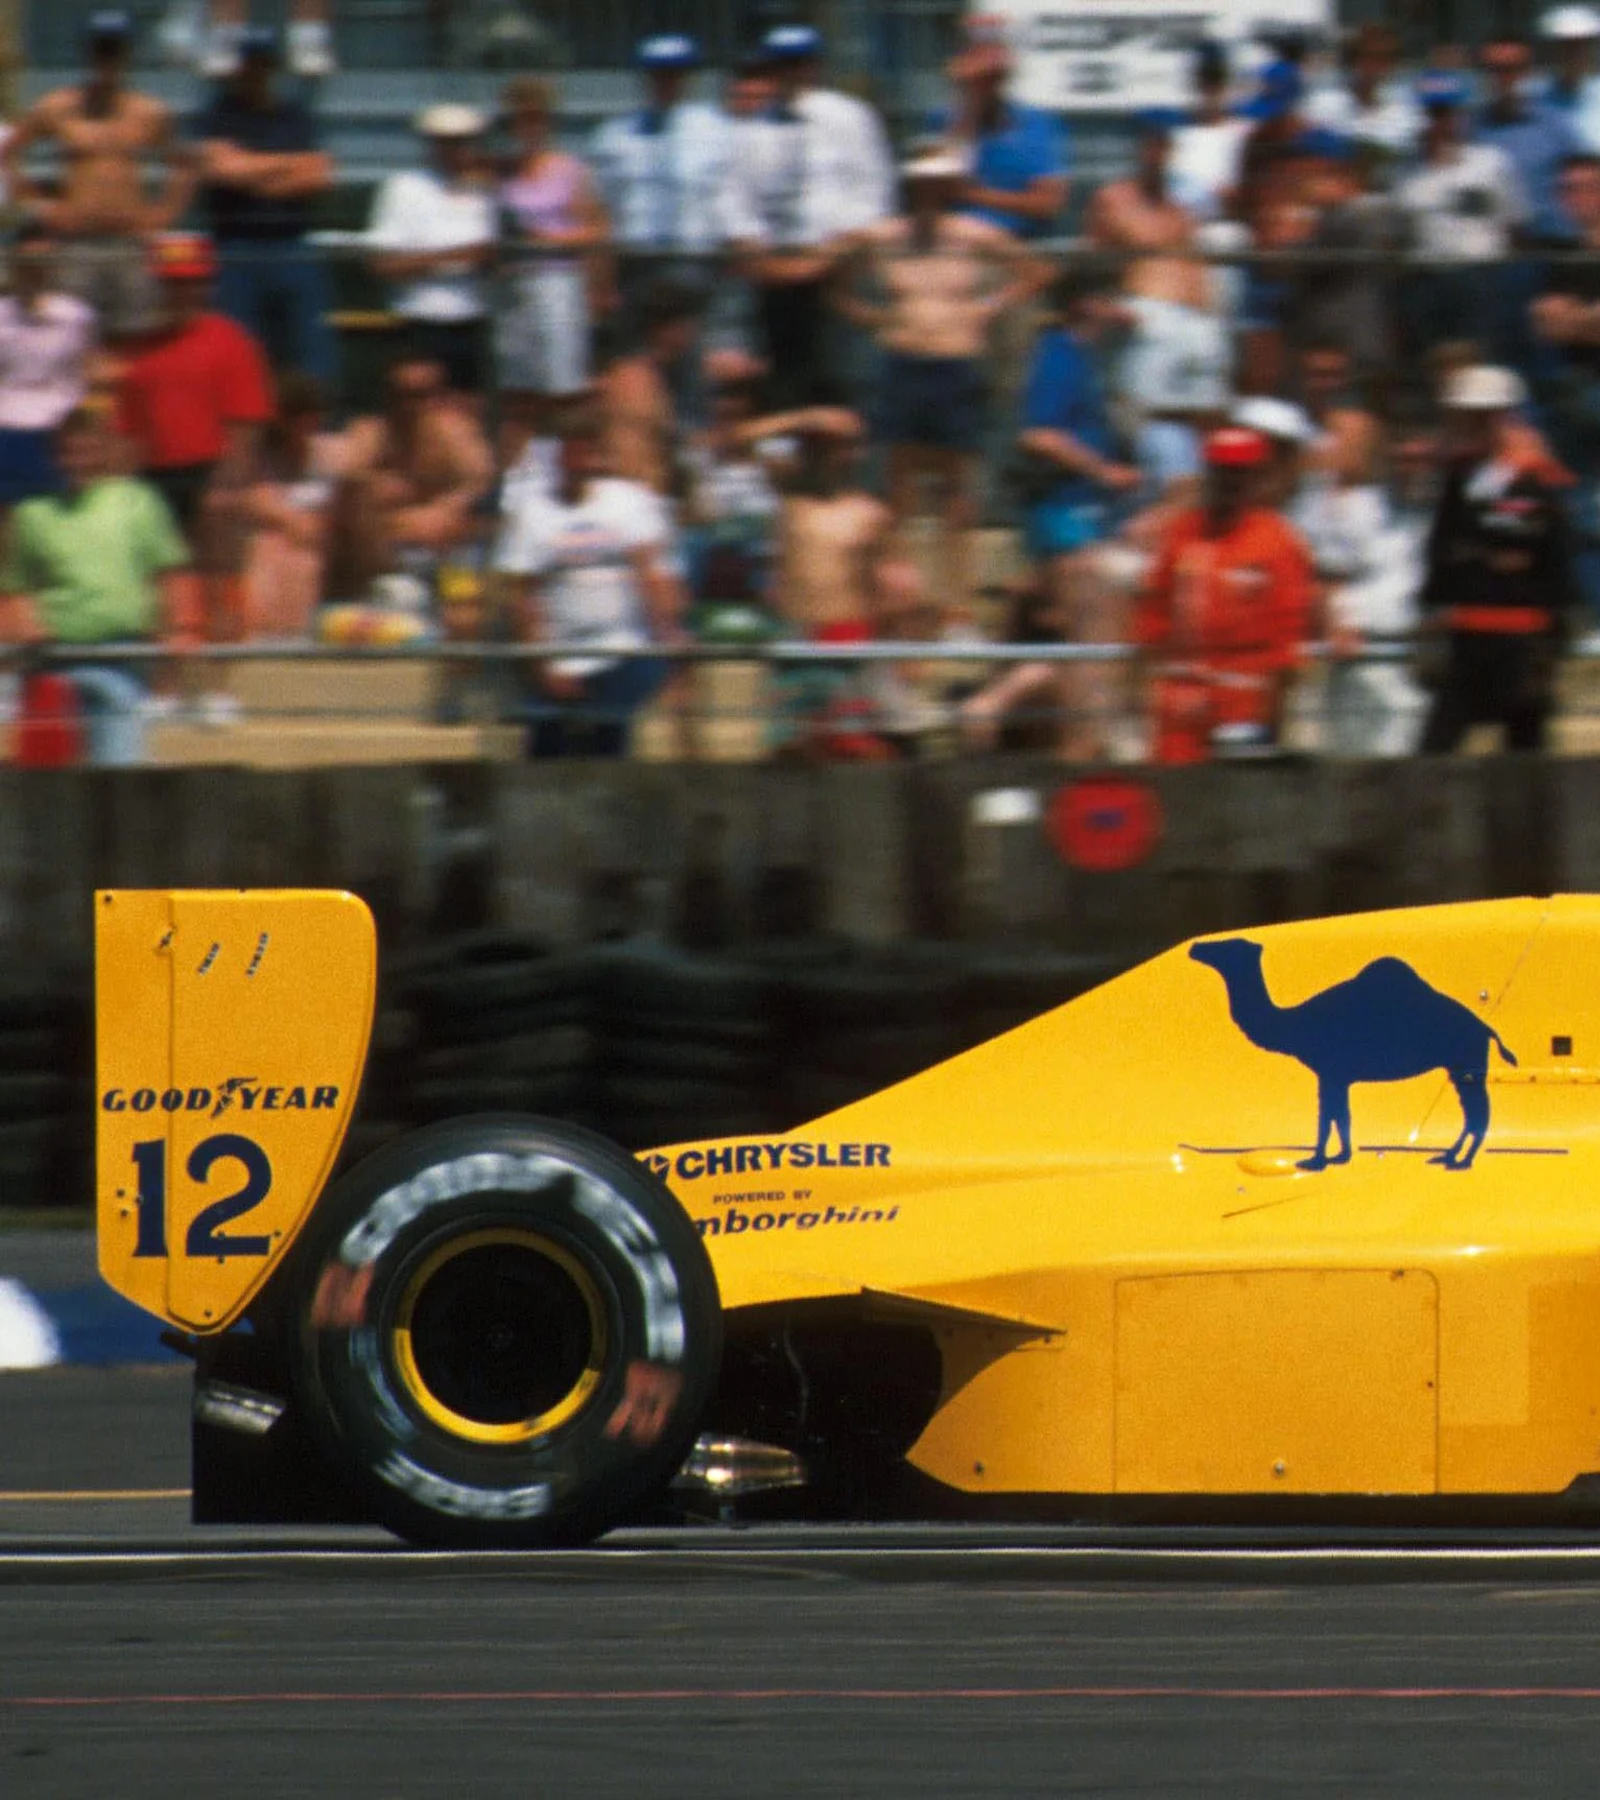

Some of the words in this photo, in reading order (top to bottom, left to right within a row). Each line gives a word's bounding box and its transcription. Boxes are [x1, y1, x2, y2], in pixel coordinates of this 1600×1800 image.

[676, 1142, 892, 1180] CHRYSLER
[131, 1133, 272, 1257] 12
[713, 1191, 786, 1204] POWERED
[792, 1189, 812, 1200] BY
[695, 1205, 900, 1236] mborghini
